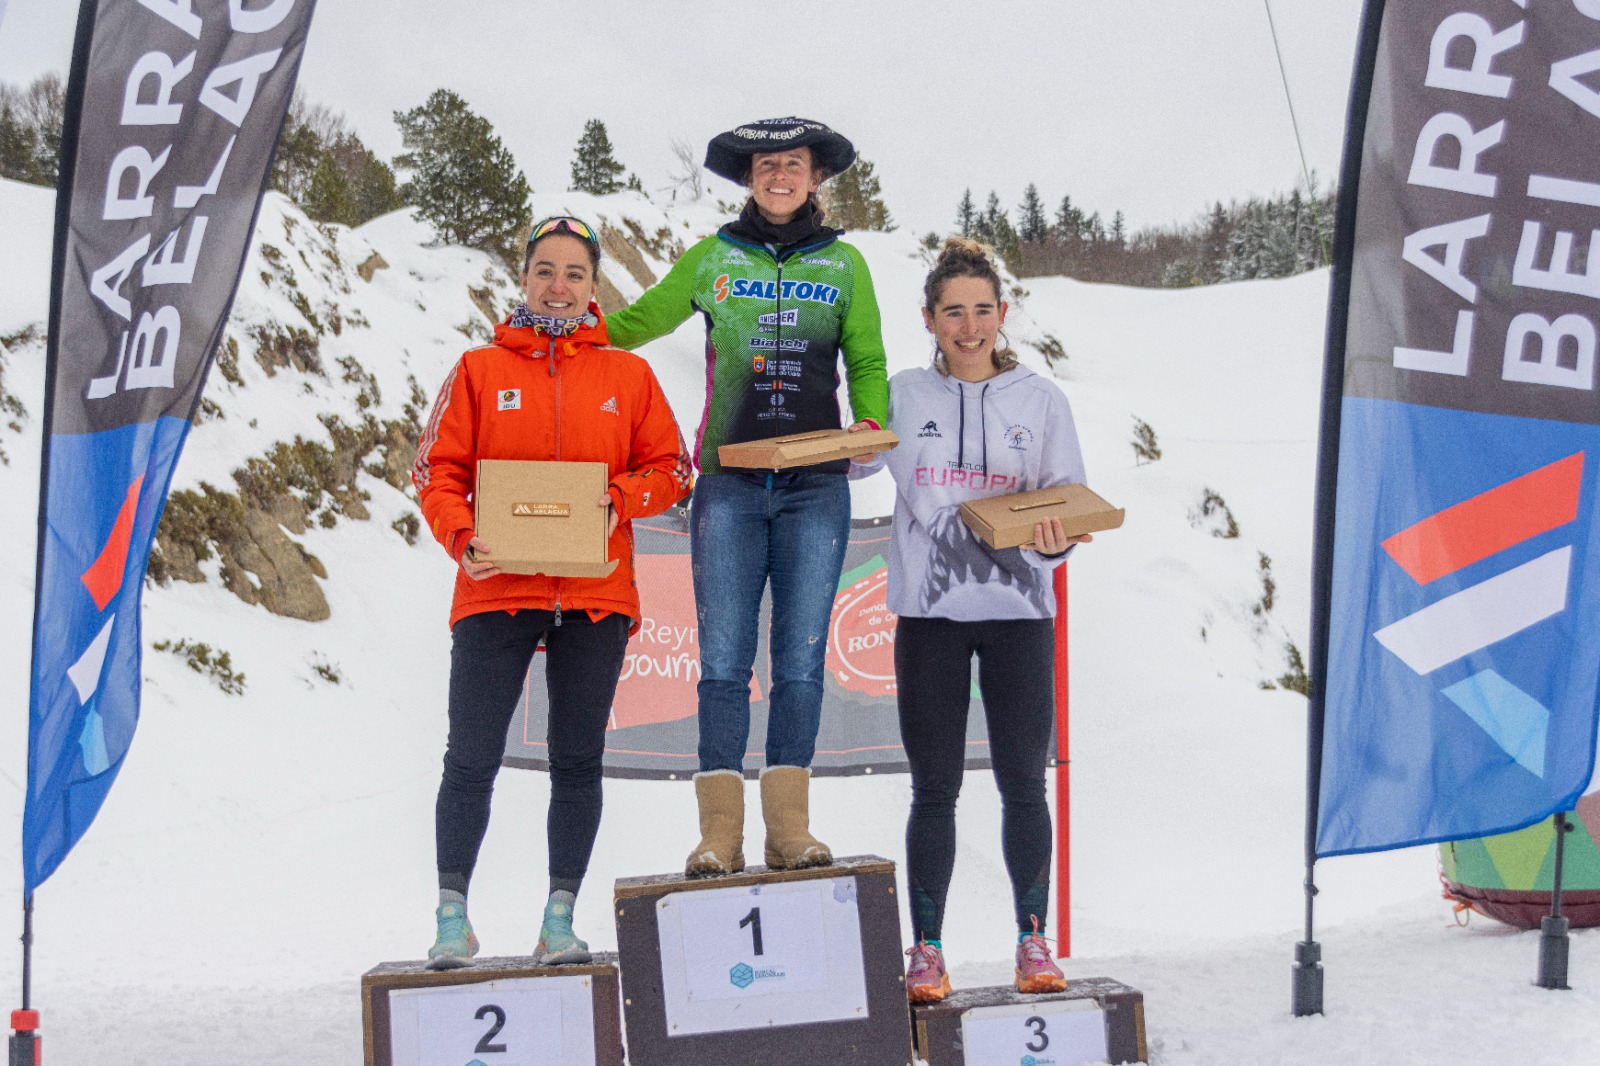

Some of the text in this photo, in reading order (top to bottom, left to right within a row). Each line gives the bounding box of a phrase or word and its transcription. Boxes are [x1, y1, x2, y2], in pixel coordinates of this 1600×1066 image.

[769, 126, 805, 140] NEGUKO
[1393, 0, 1528, 376] LARR
[732, 278, 840, 306] SALTOKI
[739, 907, 763, 956] 1
[474, 1004, 507, 1053] 2
[1025, 1016, 1049, 1052] 3
